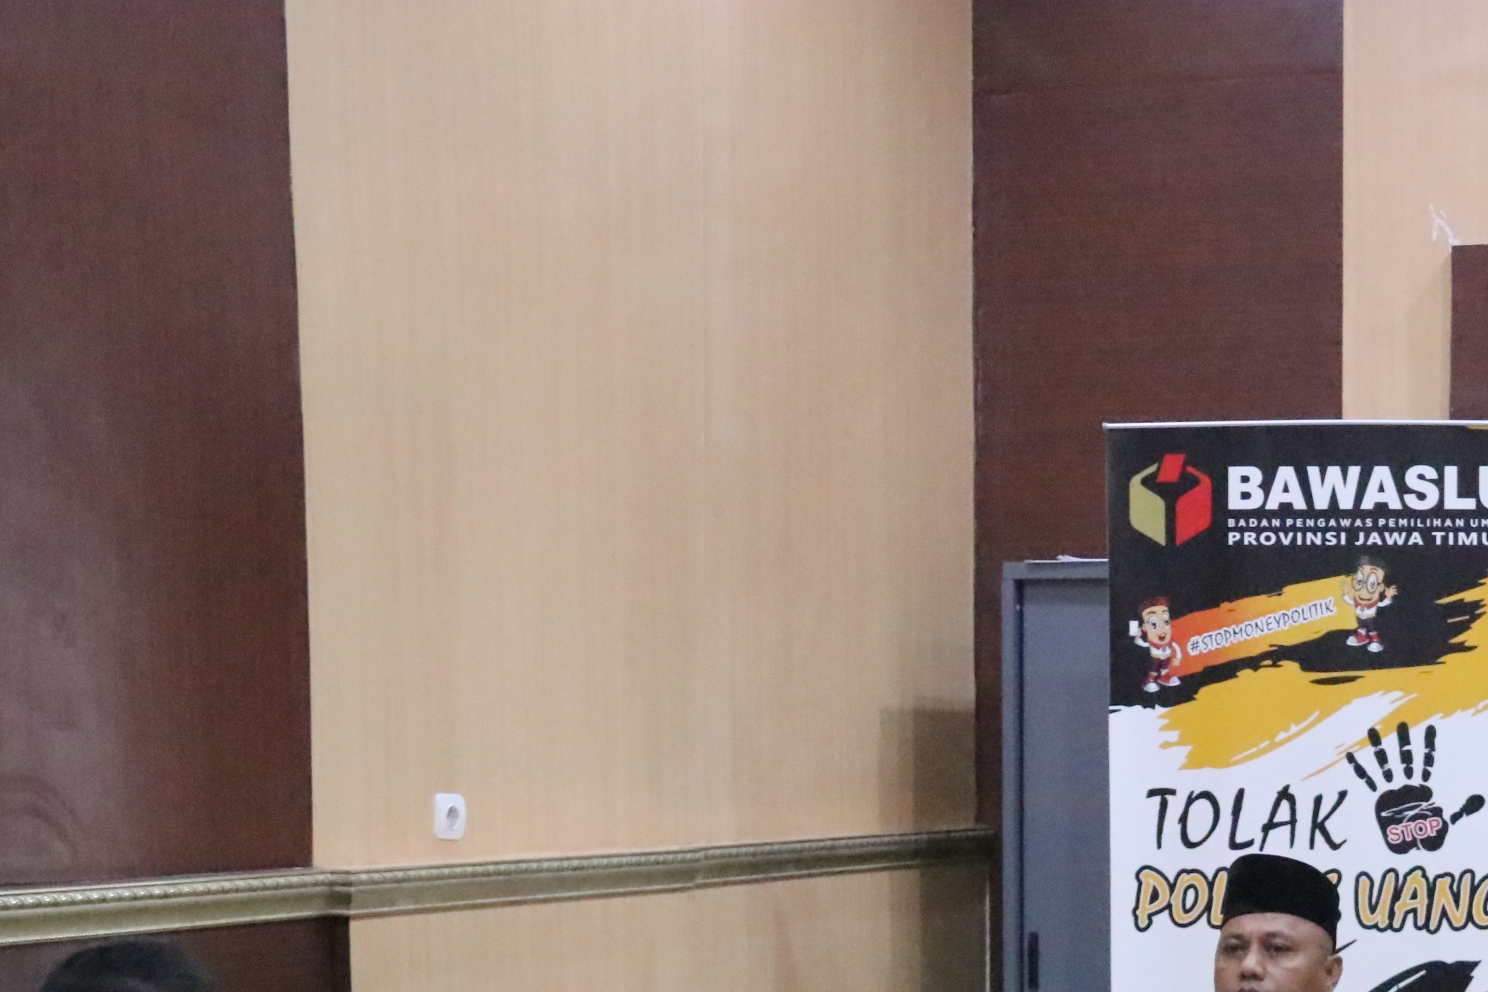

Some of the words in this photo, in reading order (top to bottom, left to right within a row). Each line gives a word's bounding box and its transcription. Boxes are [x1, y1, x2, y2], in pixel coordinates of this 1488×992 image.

[1227, 518, 1281, 528] BADAN
[1285, 518, 1374, 528] PENGAWAS
[1378, 518, 1465, 528] PEMILIHAN
[1227, 531, 1347, 546] PROVINSI
[1354, 531, 1425, 546] JAWA
[1187, 596, 1336, 655] #STOPMONEYPOLITIK
[1145, 784, 1349, 851] TOLAK
[1386, 816, 1443, 845] STOP
